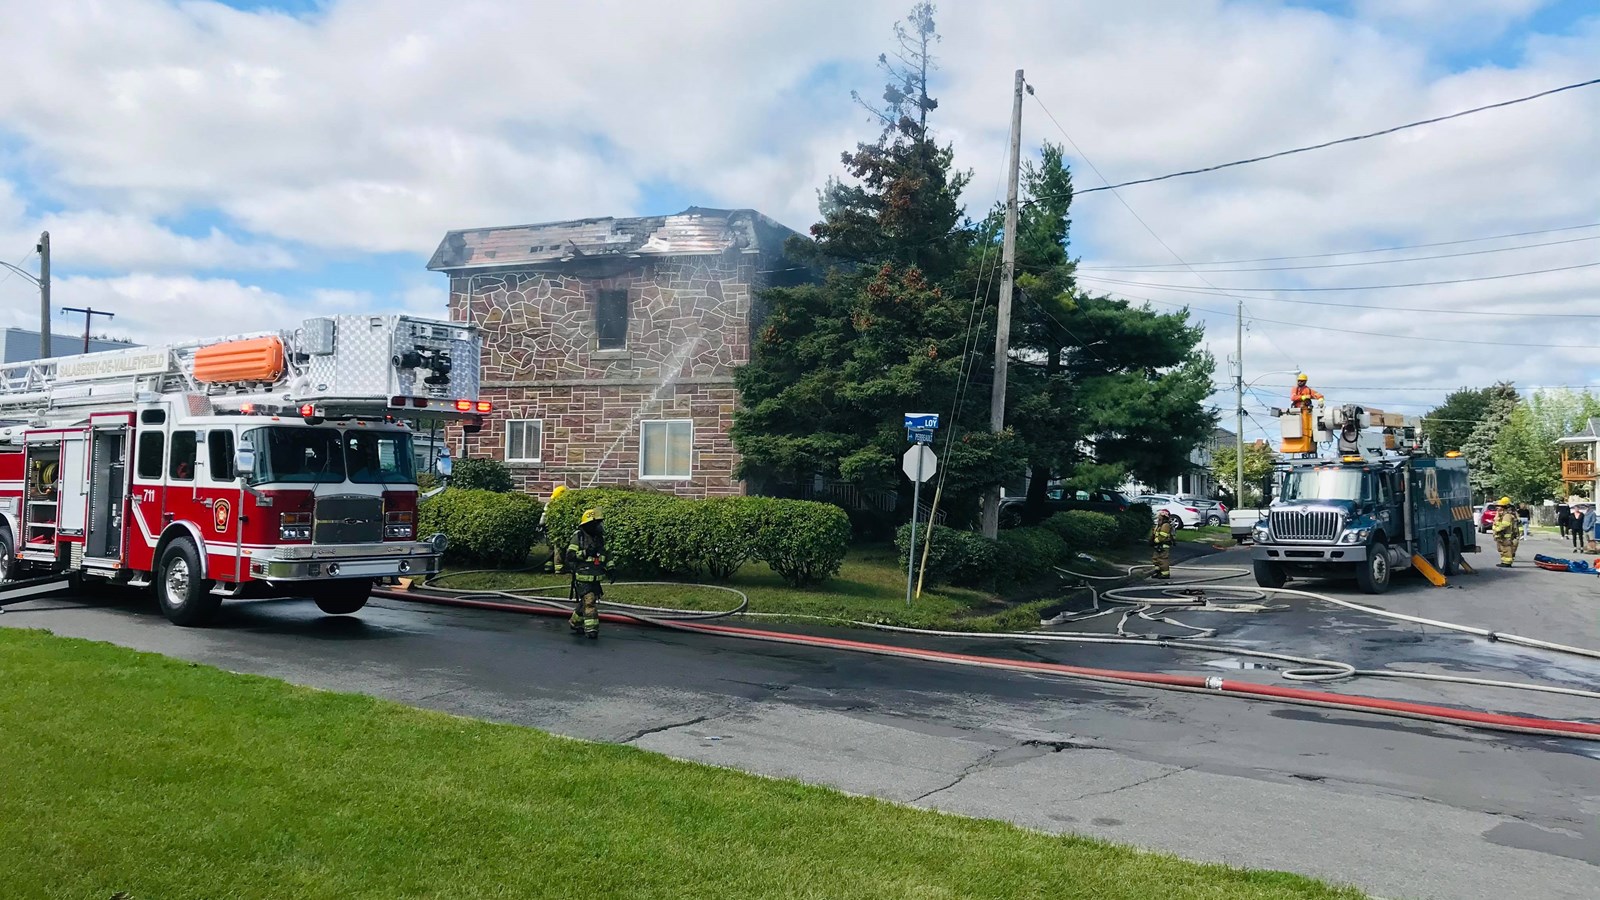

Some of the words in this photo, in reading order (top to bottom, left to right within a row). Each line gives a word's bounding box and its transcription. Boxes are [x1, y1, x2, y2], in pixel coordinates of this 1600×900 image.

[59, 353, 165, 377] SALABERRY-DE-VALLEYFIELD
[924, 419, 937, 427] LOY
[143, 489, 155, 502] 711
